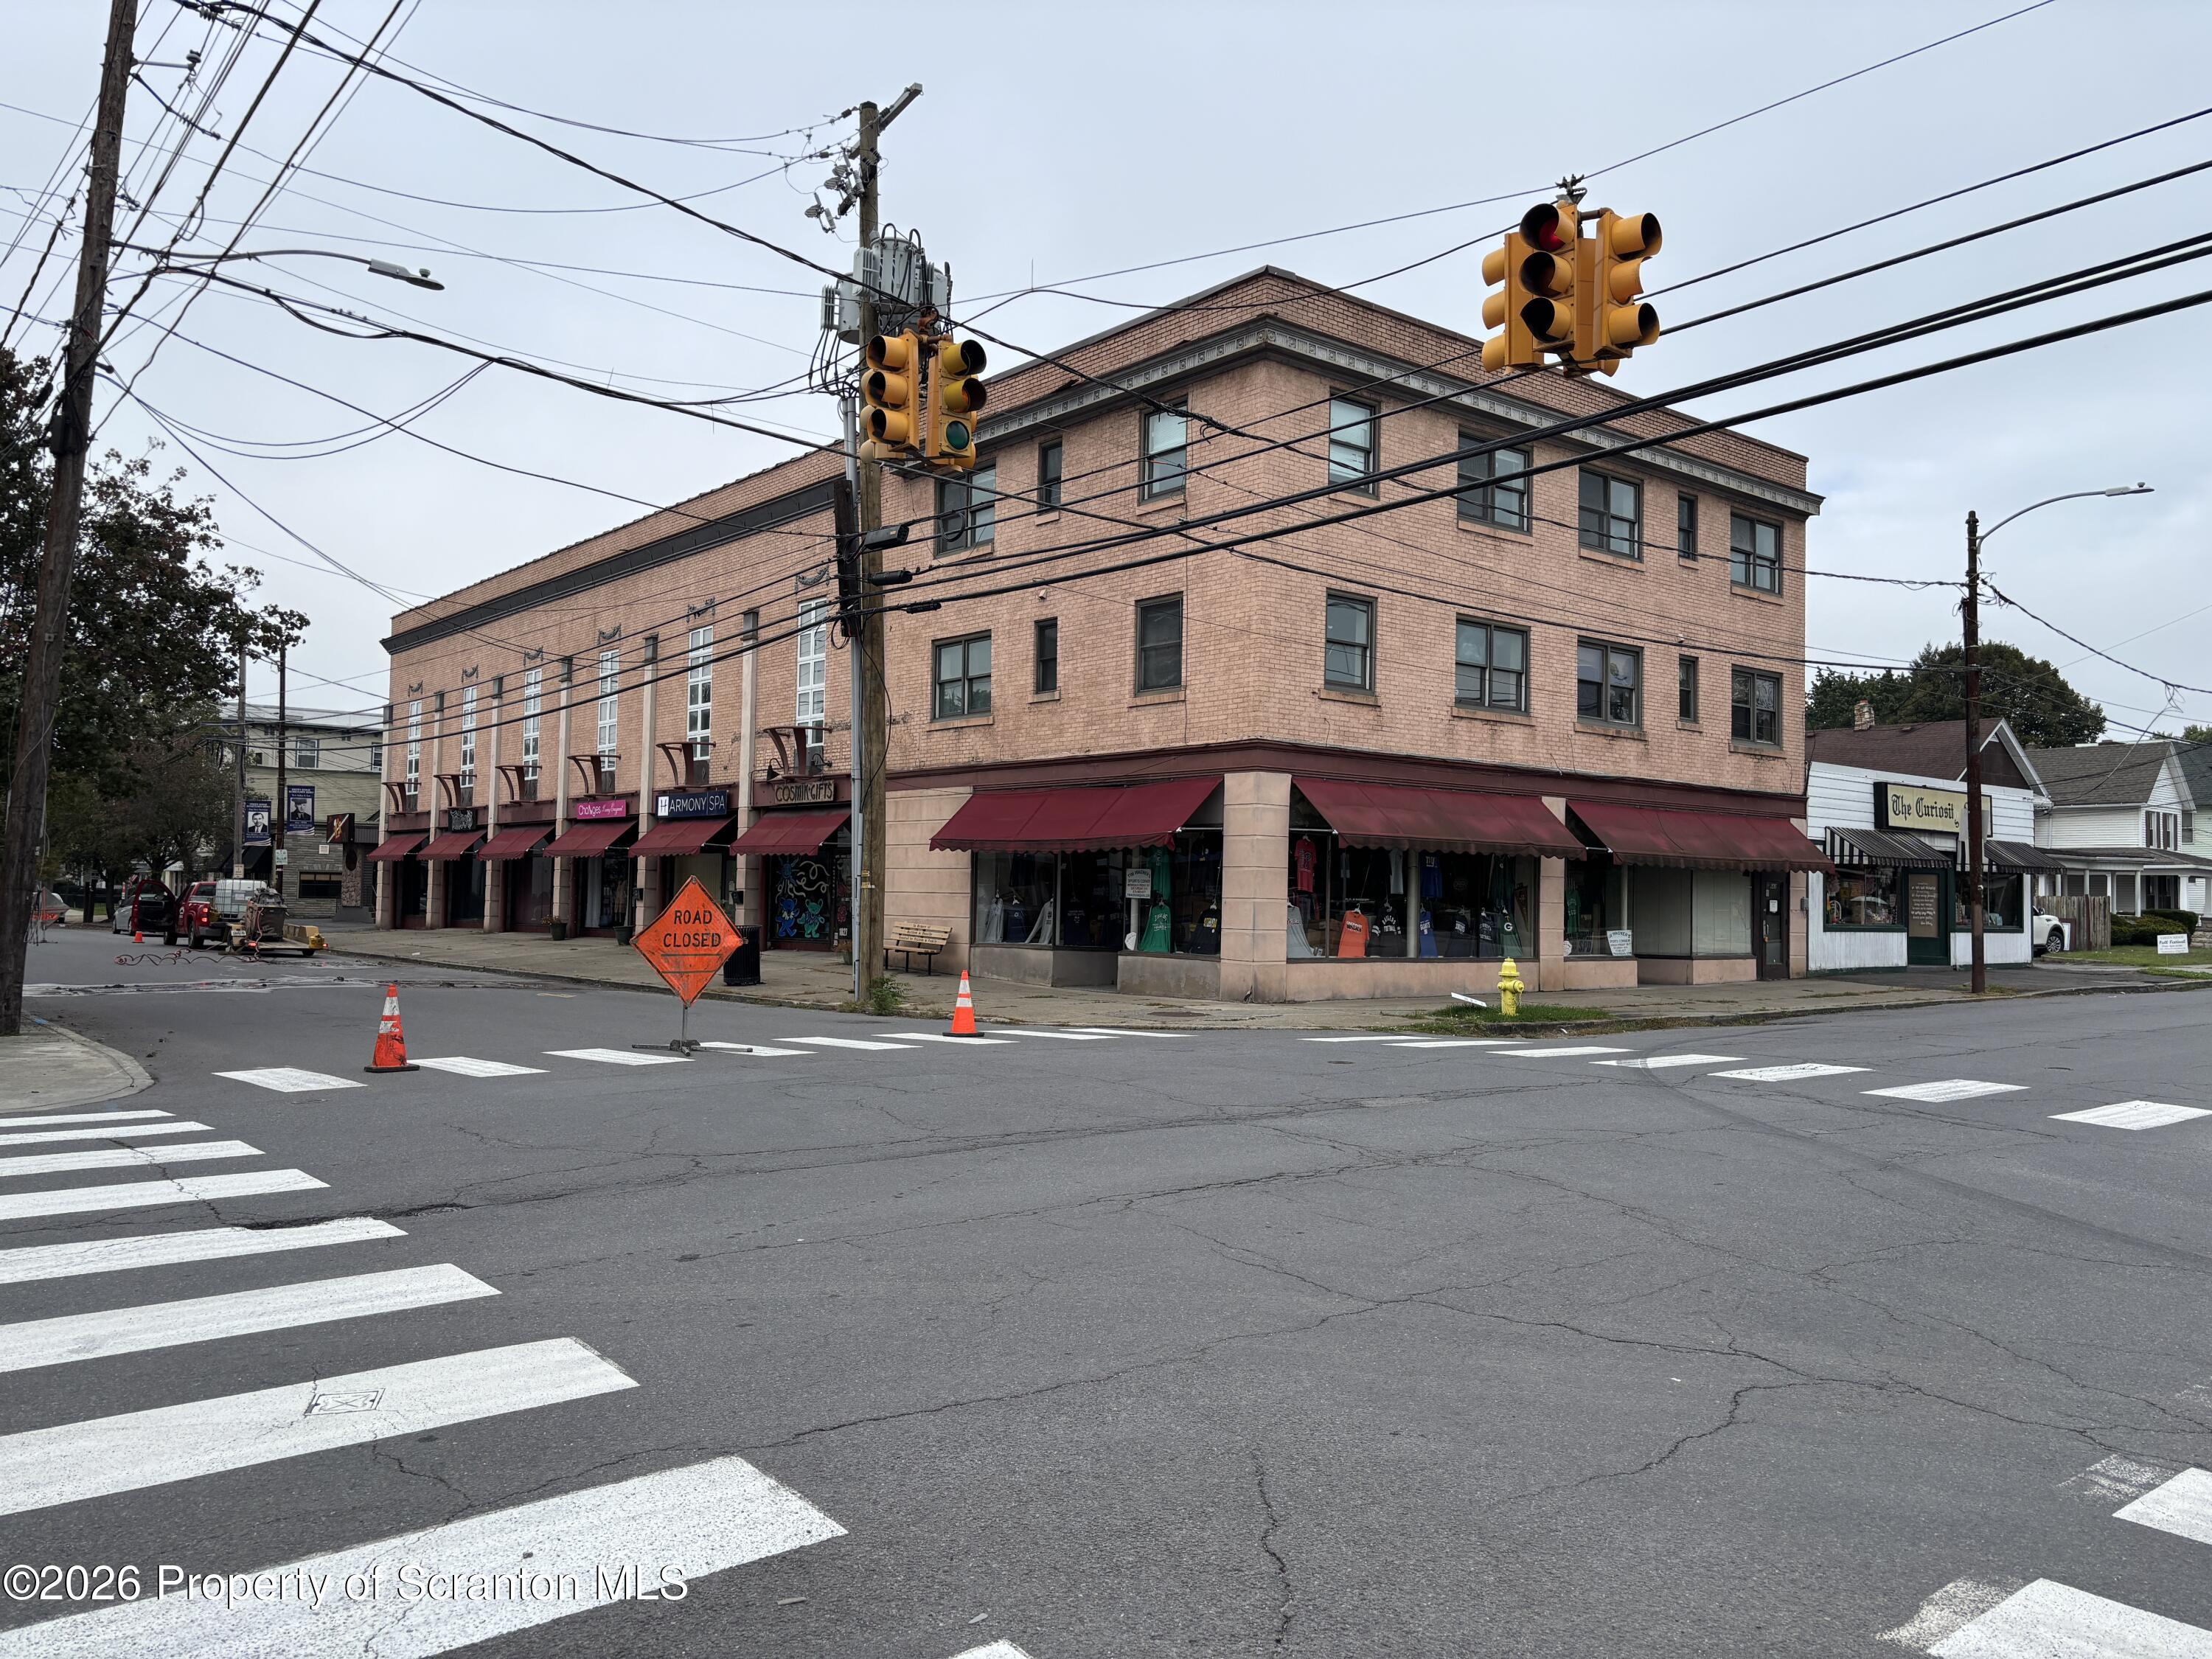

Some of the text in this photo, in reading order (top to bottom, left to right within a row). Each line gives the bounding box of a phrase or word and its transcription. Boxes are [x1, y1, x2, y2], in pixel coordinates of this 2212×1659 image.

[776, 782, 832, 801] COSMIK GIFTS
[660, 795, 726, 813] HARMONY SPA
[1891, 794, 1912, 821] The
[674, 910, 713, 925] ROAD
[1503, 922, 1513, 931] G
[663, 933, 721, 947] CLOSED
